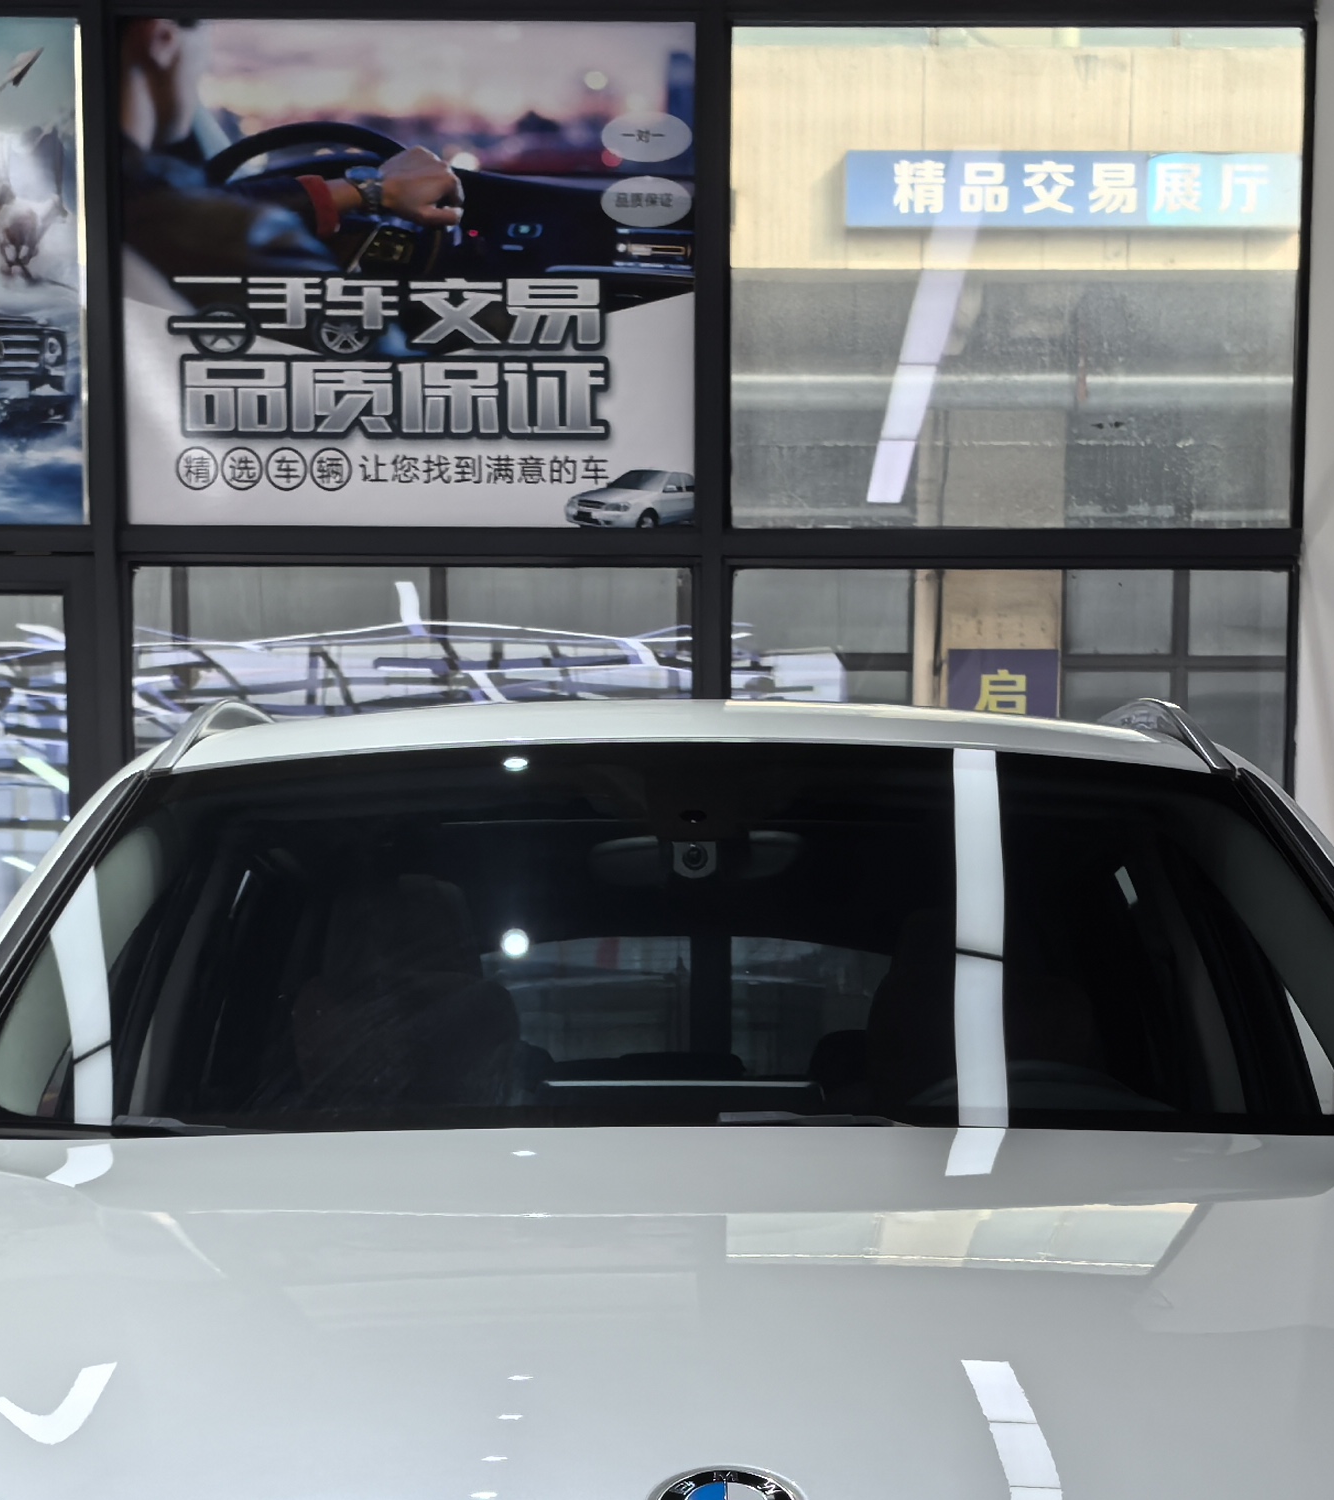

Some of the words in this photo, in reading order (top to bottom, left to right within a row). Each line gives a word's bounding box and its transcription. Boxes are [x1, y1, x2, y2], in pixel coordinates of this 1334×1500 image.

[619, 128, 666, 143] 一对一
[614, 191, 674, 208] 品质保证
[892, 158, 1270, 215] 精品交易展厅
[169, 276, 603, 348] 二手车交易
[182, 356, 608, 438] 品质保证
[178, 449, 350, 488] 精选车辆
[357, 454, 610, 486] 让您找到满意的车
[973, 668, 1027, 715] 启
[669, 1470, 784, 1496] BMW
